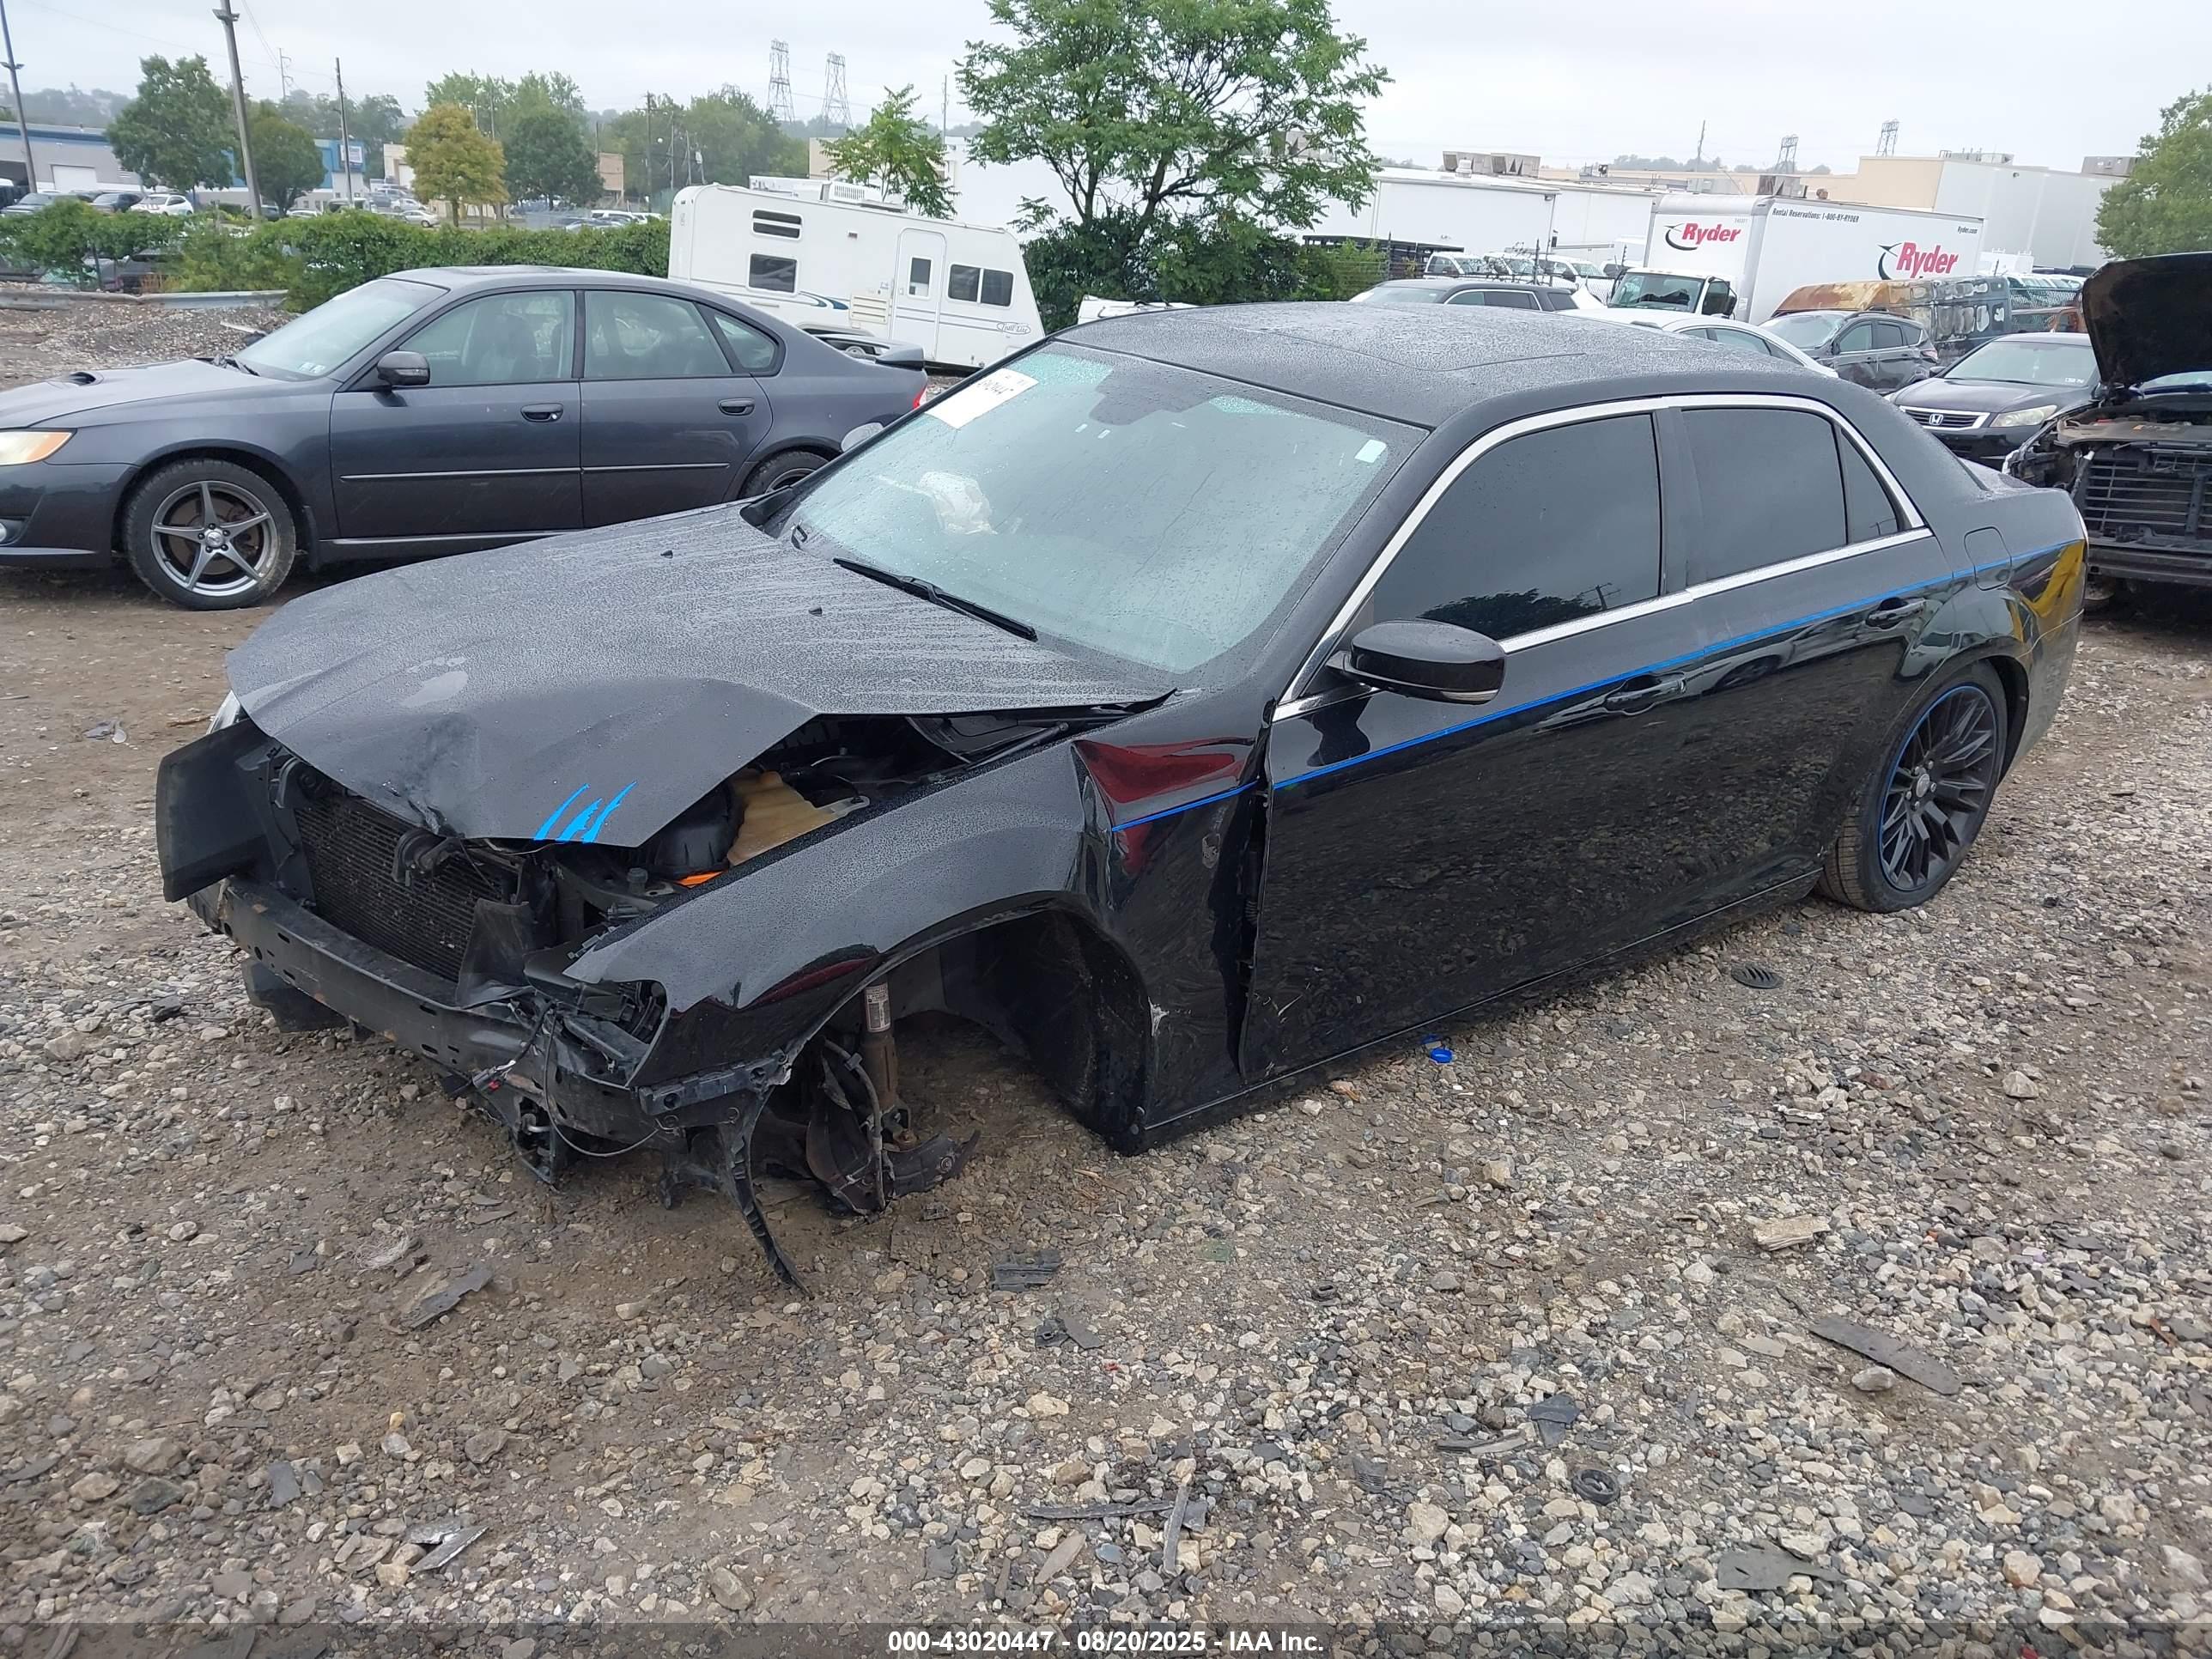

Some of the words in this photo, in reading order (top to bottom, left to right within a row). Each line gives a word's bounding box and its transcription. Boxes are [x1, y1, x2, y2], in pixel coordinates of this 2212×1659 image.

[1772, 208, 1788, 216] Rental
[1789, 210, 1820, 220] Reservations:
[1682, 223, 1741, 245] Ryder
[1896, 242, 1959, 278] Ryder
